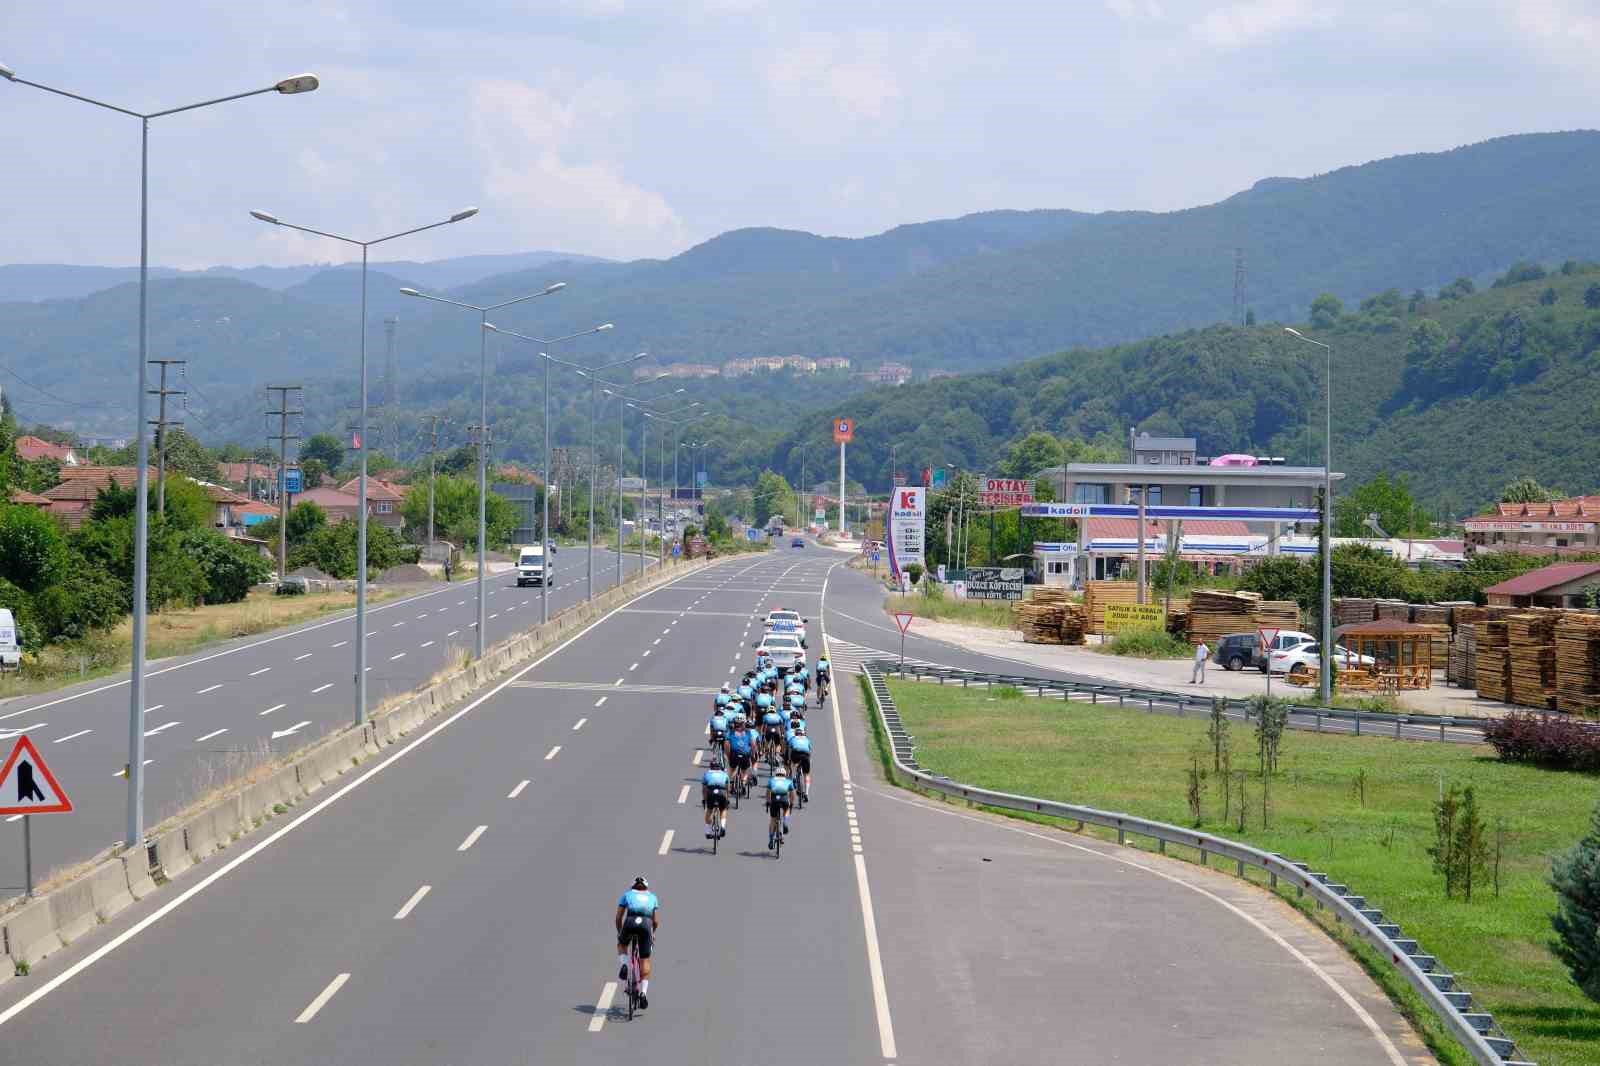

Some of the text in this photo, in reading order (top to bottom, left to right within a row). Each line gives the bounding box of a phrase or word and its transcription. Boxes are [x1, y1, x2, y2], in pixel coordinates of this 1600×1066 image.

[988, 480, 1027, 492] OKTAY
[894, 510, 922, 518] kadoil
[1050, 506, 1087, 516] kadoil
